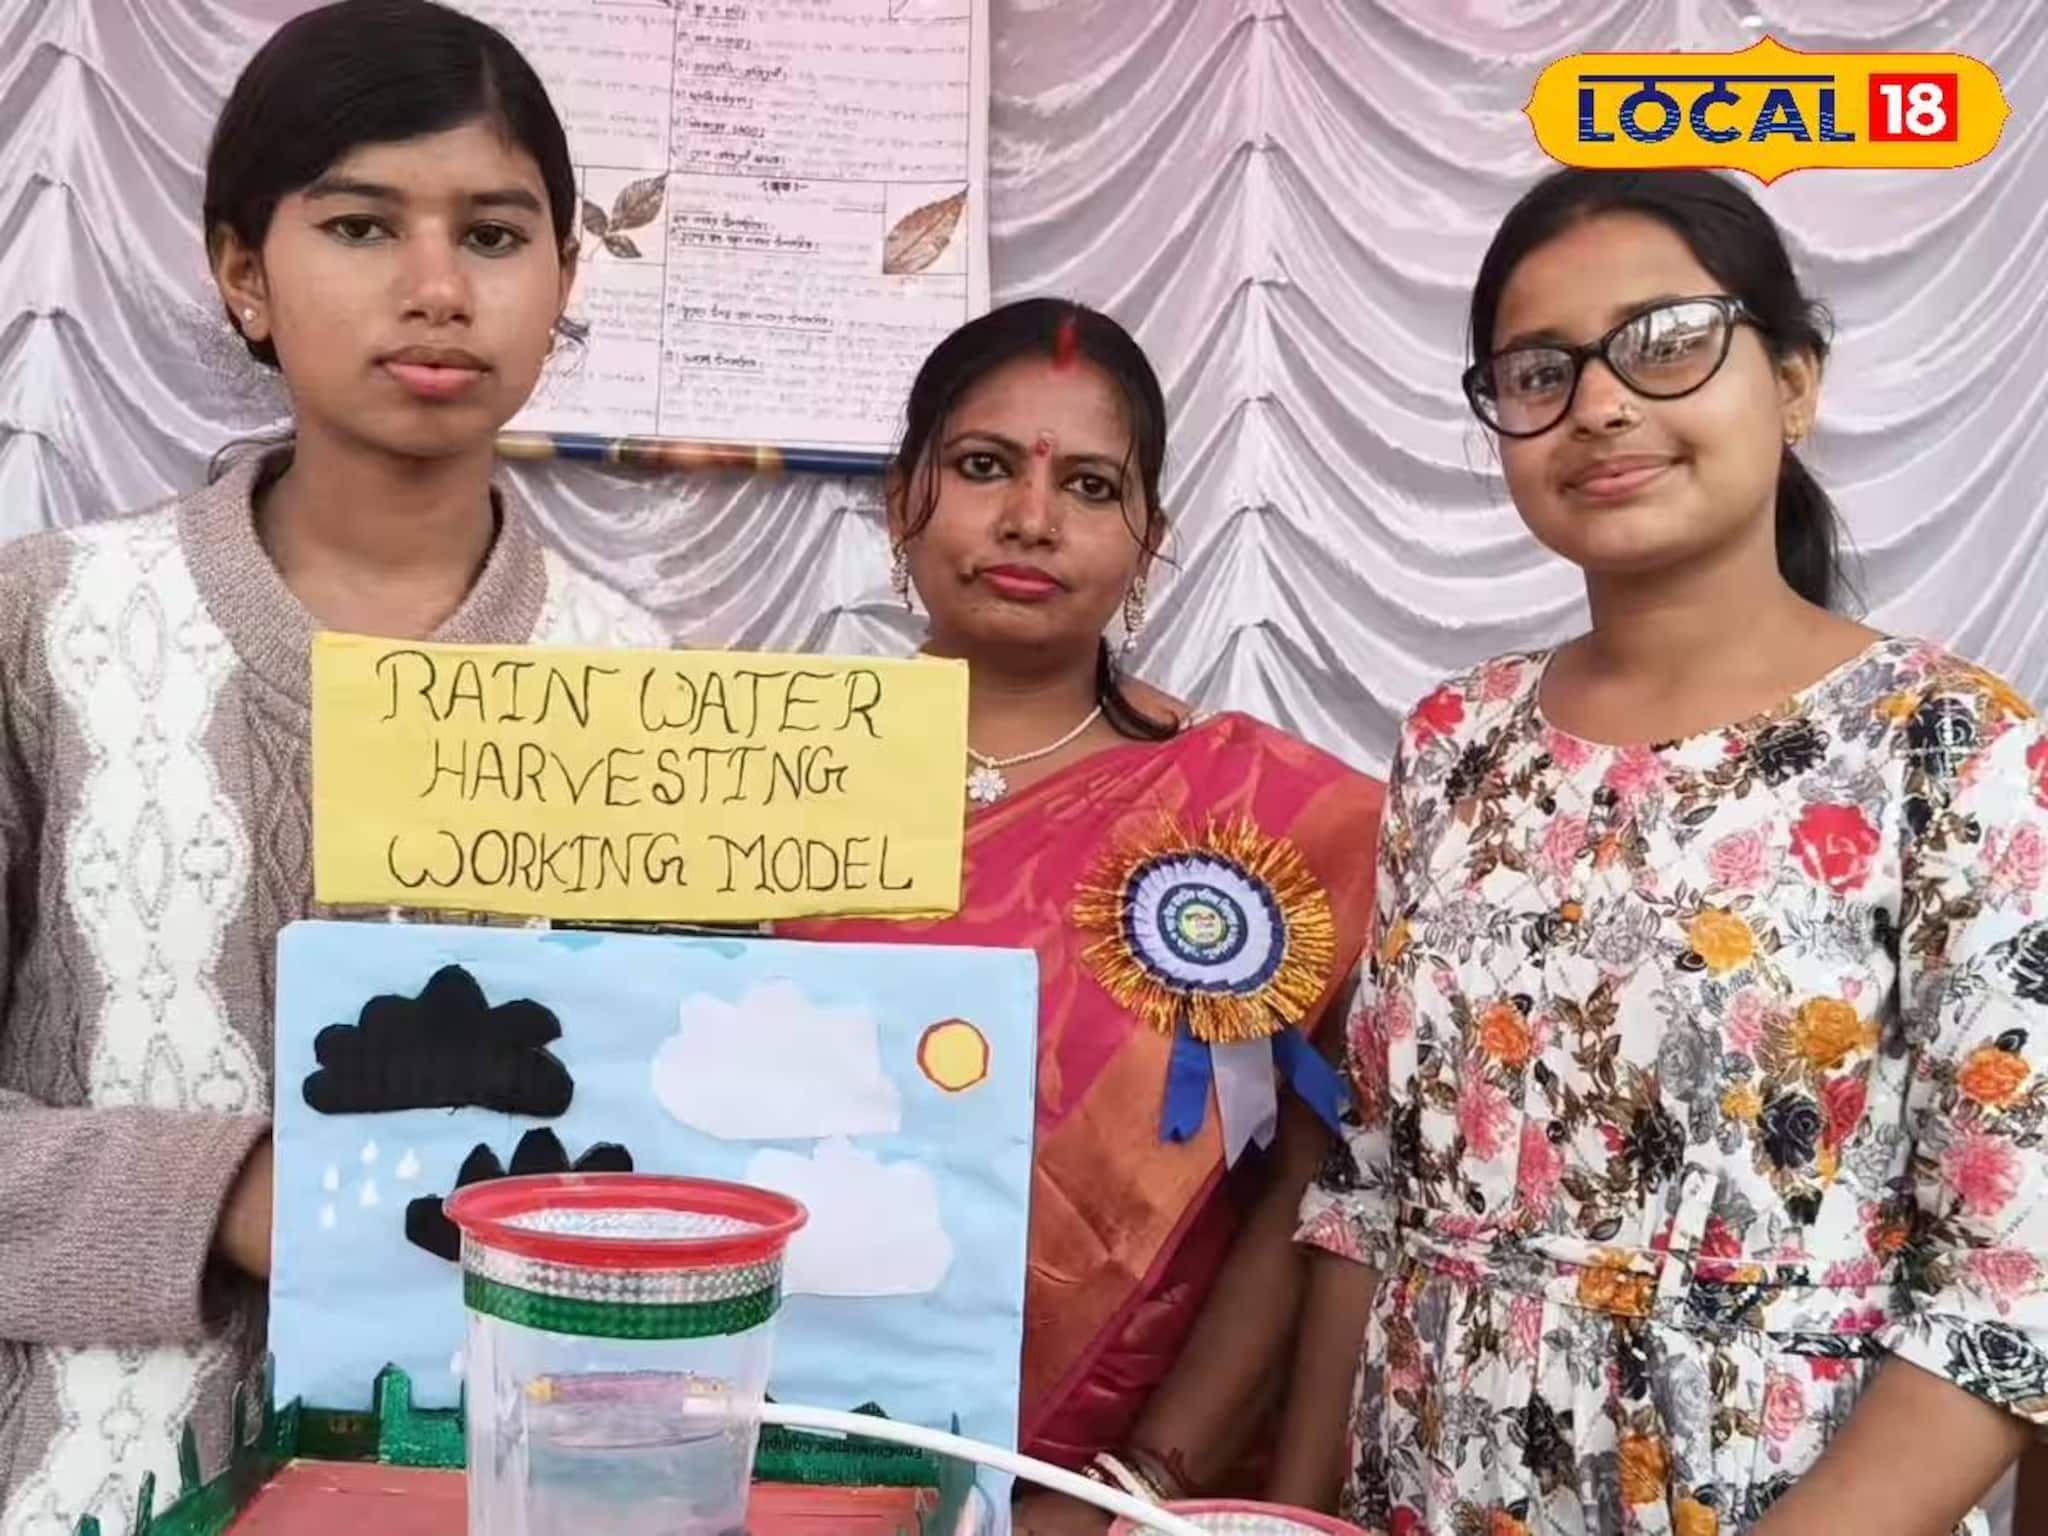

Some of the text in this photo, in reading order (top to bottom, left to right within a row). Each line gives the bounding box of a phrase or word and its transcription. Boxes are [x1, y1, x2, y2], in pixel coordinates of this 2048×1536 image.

[376, 650, 883, 738] RAIN WATER
[419, 738, 849, 807] HARVESTING
[388, 829, 914, 894] WORKING MODEL
